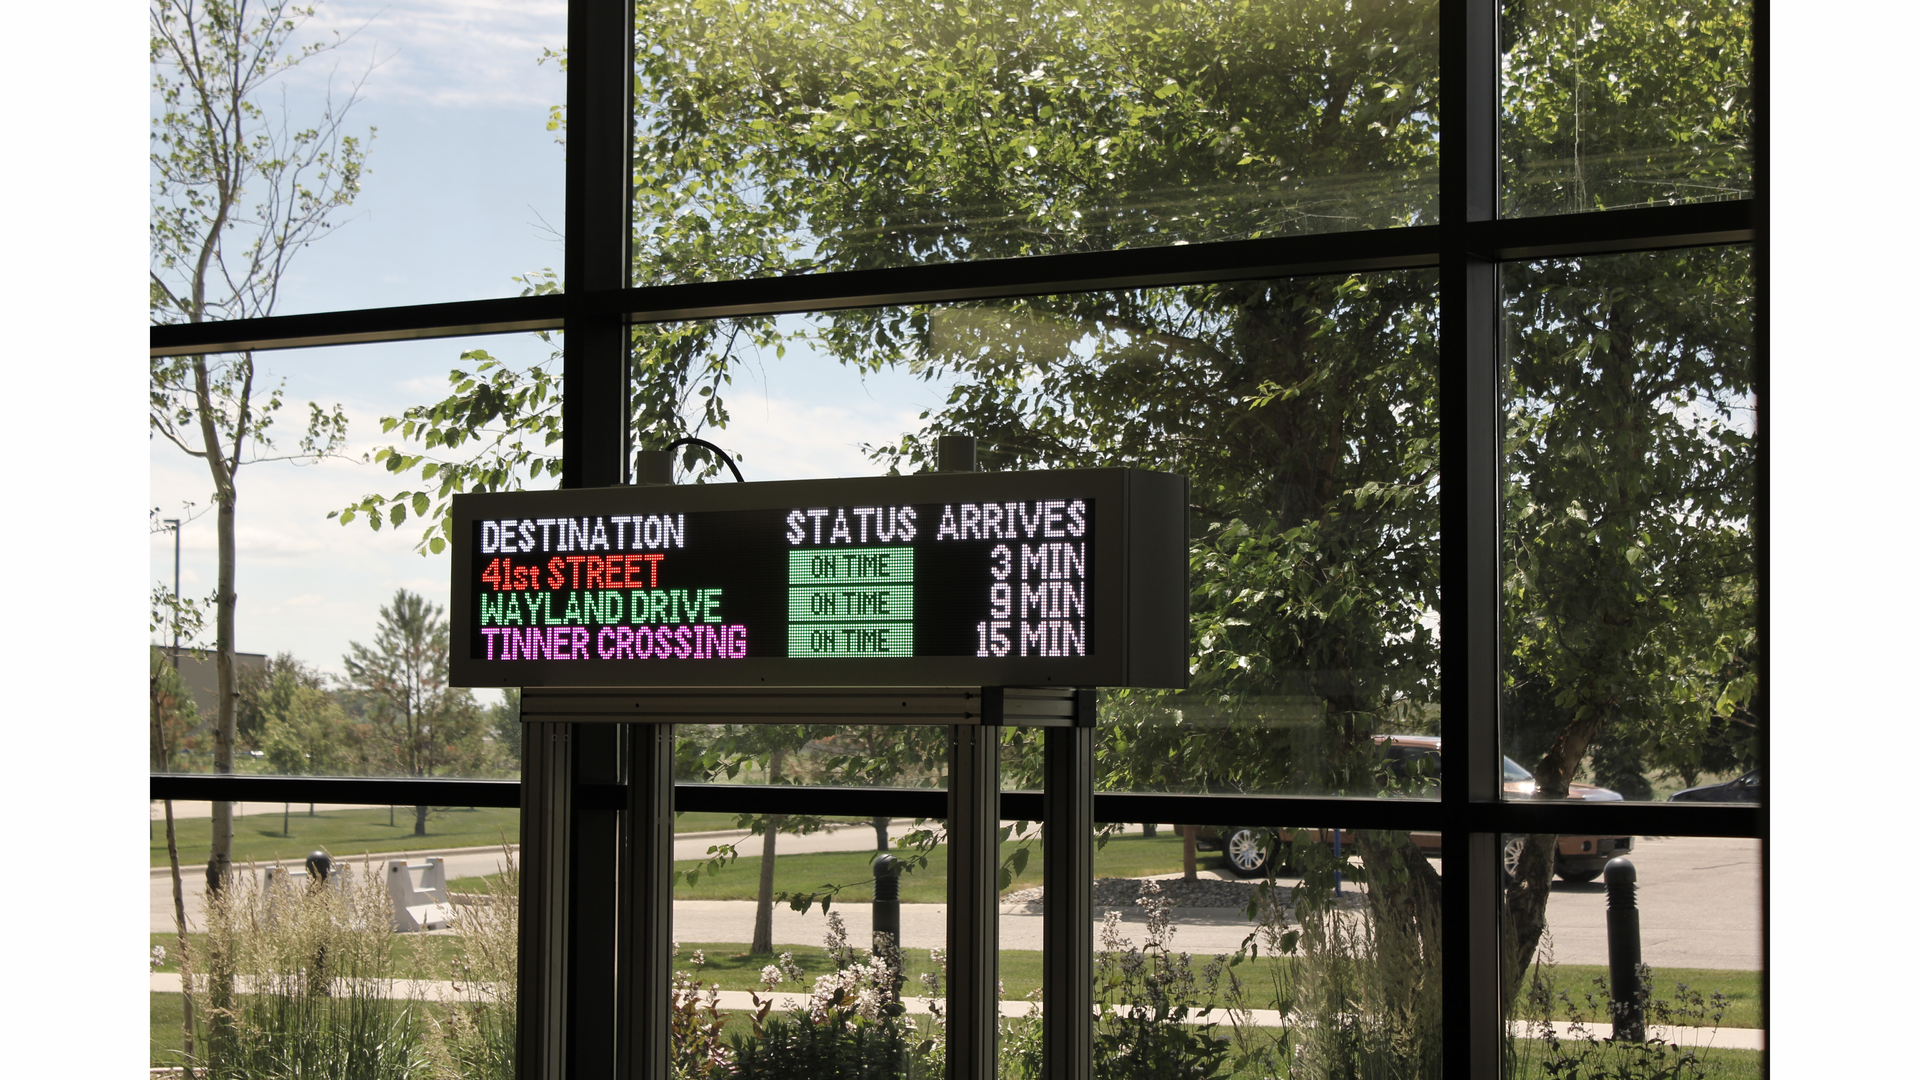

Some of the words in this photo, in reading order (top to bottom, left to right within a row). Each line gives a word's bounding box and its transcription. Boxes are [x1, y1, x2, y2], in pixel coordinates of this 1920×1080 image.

[482, 514, 684, 553] DESTINATION
[786, 507, 917, 545] STATUS
[937, 500, 1086, 540] ARRIVES
[482, 558, 540, 590] 41st
[547, 554, 665, 589] STREET
[811, 557, 837, 578] ON
[844, 555, 890, 577] TIME
[991, 545, 1012, 580] 3
[1020, 543, 1086, 579] MIN
[481, 592, 623, 625] WAYLAND
[630, 589, 722, 623] DRIVE
[811, 594, 837, 615] ON
[844, 593, 890, 615] TIME
[991, 583, 1012, 618] 9
[1020, 582, 1086, 618] MIN
[481, 627, 589, 660] TINNER
[597, 625, 747, 660] CROSSING
[811, 631, 837, 653] ON
[844, 630, 890, 653] TIME
[977, 622, 1011, 657] 15
[1020, 621, 1086, 657] MIN
